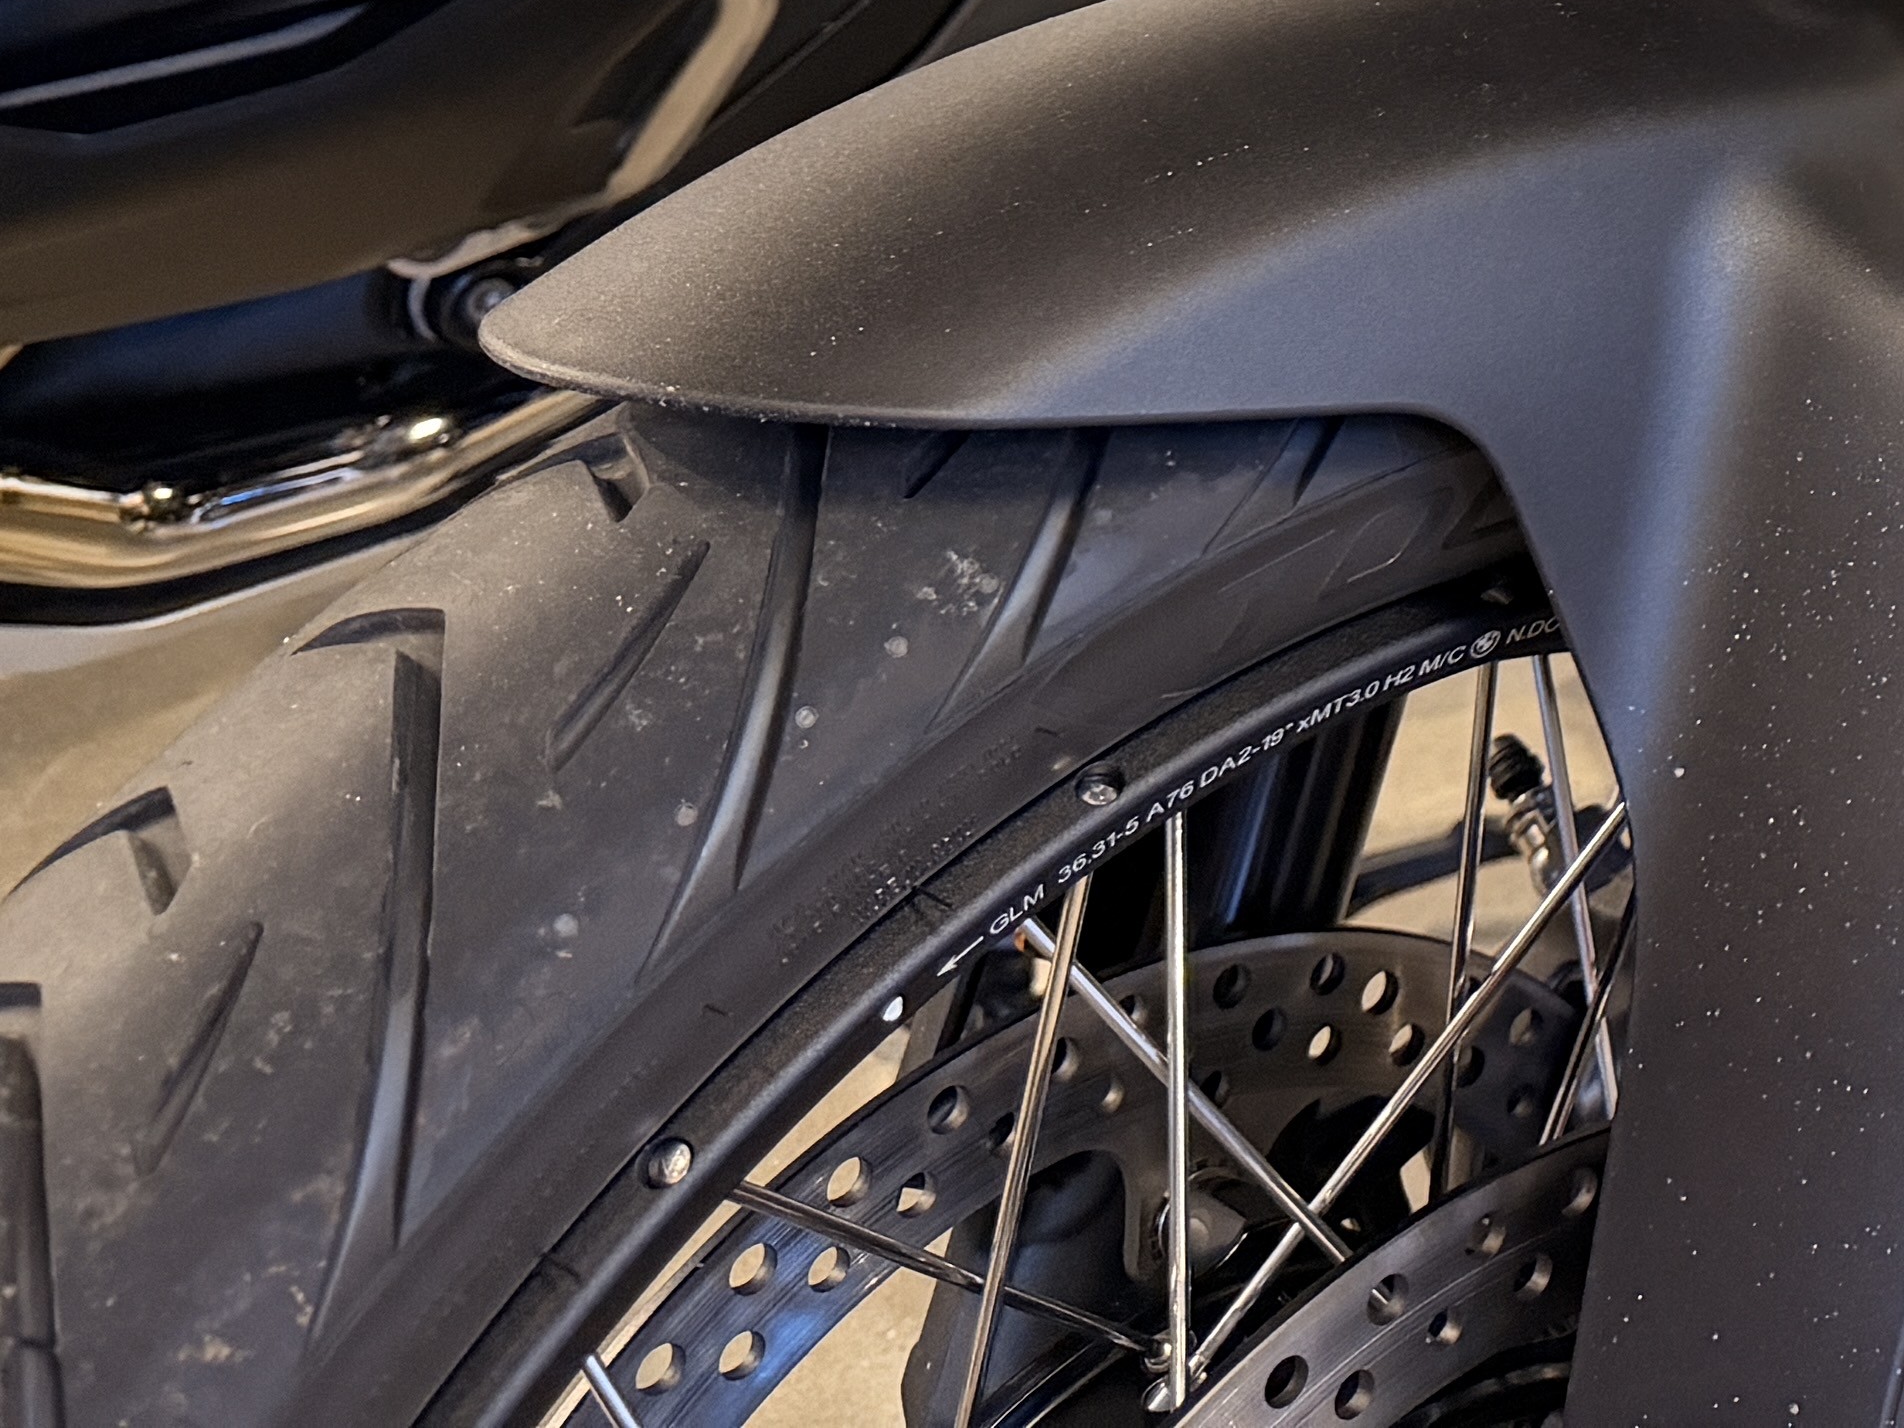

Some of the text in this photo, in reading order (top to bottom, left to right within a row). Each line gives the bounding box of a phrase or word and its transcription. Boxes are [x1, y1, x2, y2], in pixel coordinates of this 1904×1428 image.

[989, 883, 1045, 935] GLM
[1058, 815, 1140, 884] 36.31-5
[1146, 780, 1195, 823] A76
[1382, 664, 1418, 693] H2
[1418, 644, 1467, 677] M/C
